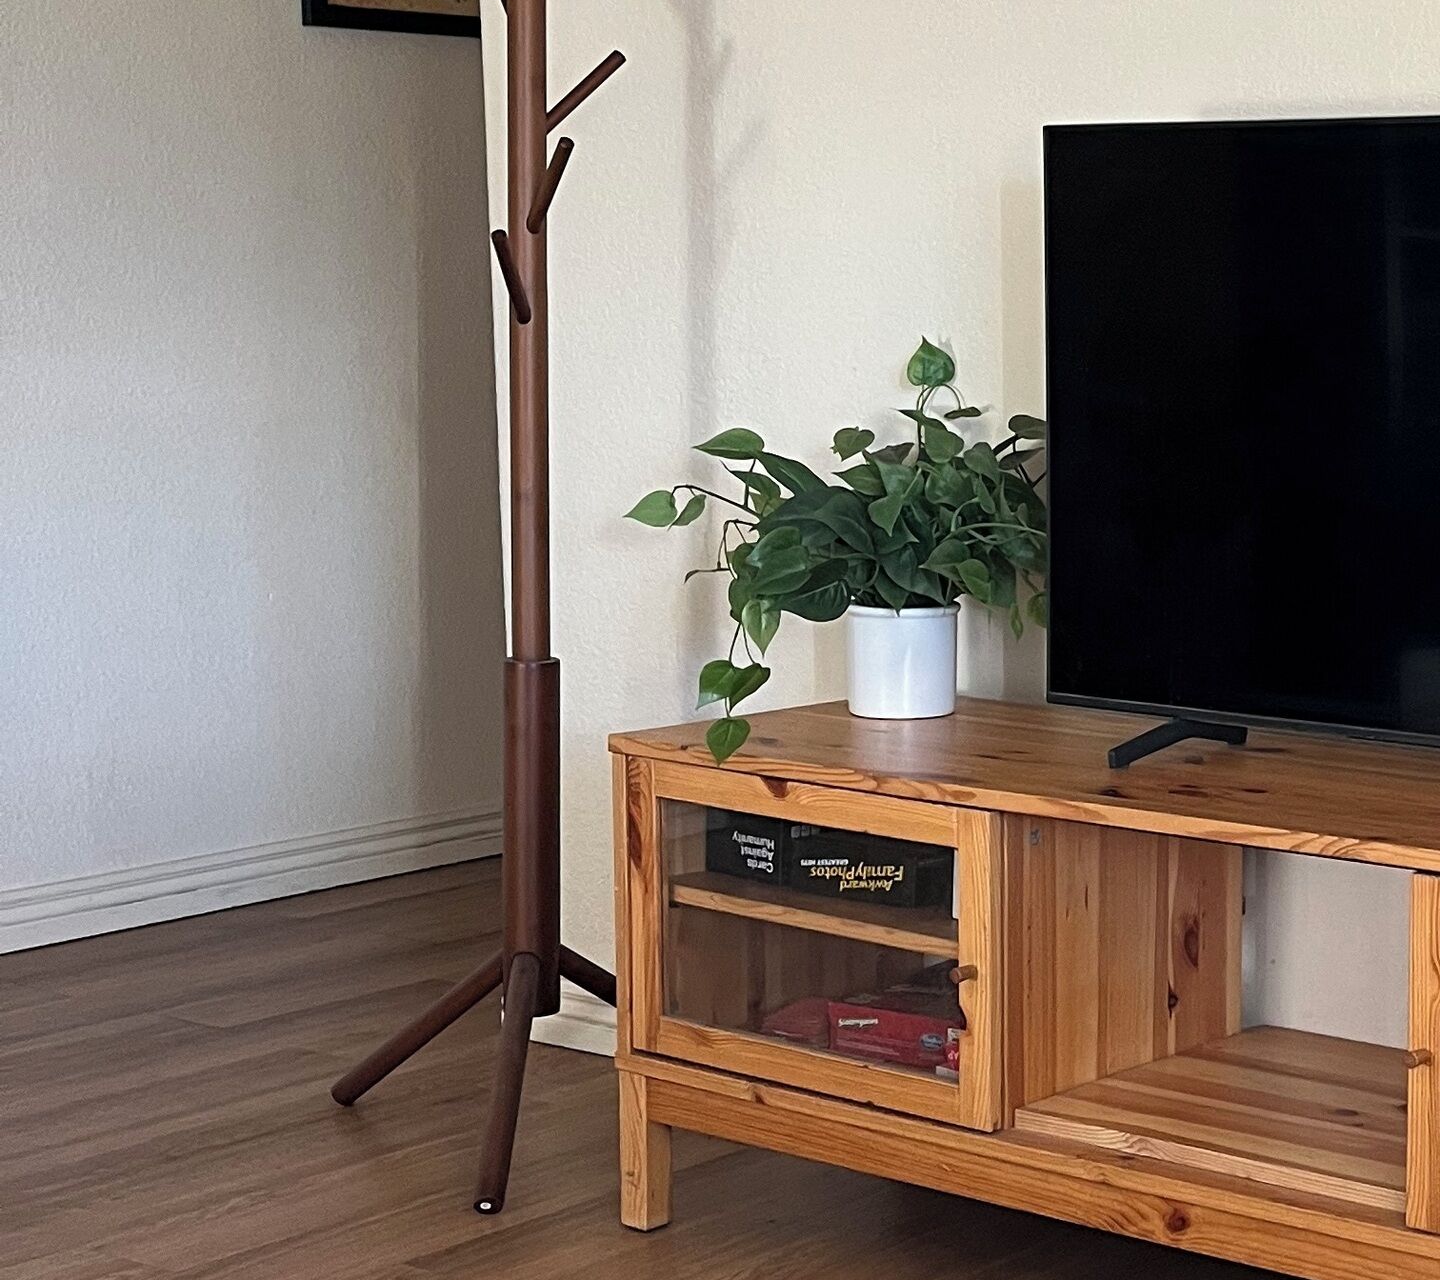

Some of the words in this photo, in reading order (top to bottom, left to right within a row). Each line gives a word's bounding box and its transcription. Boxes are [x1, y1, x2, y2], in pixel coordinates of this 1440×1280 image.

[732, 830, 775, 850] Humanity
[740, 845, 774, 862] Against
[746, 858, 774, 874] Cards
[839, 879, 893, 892] Awkward
